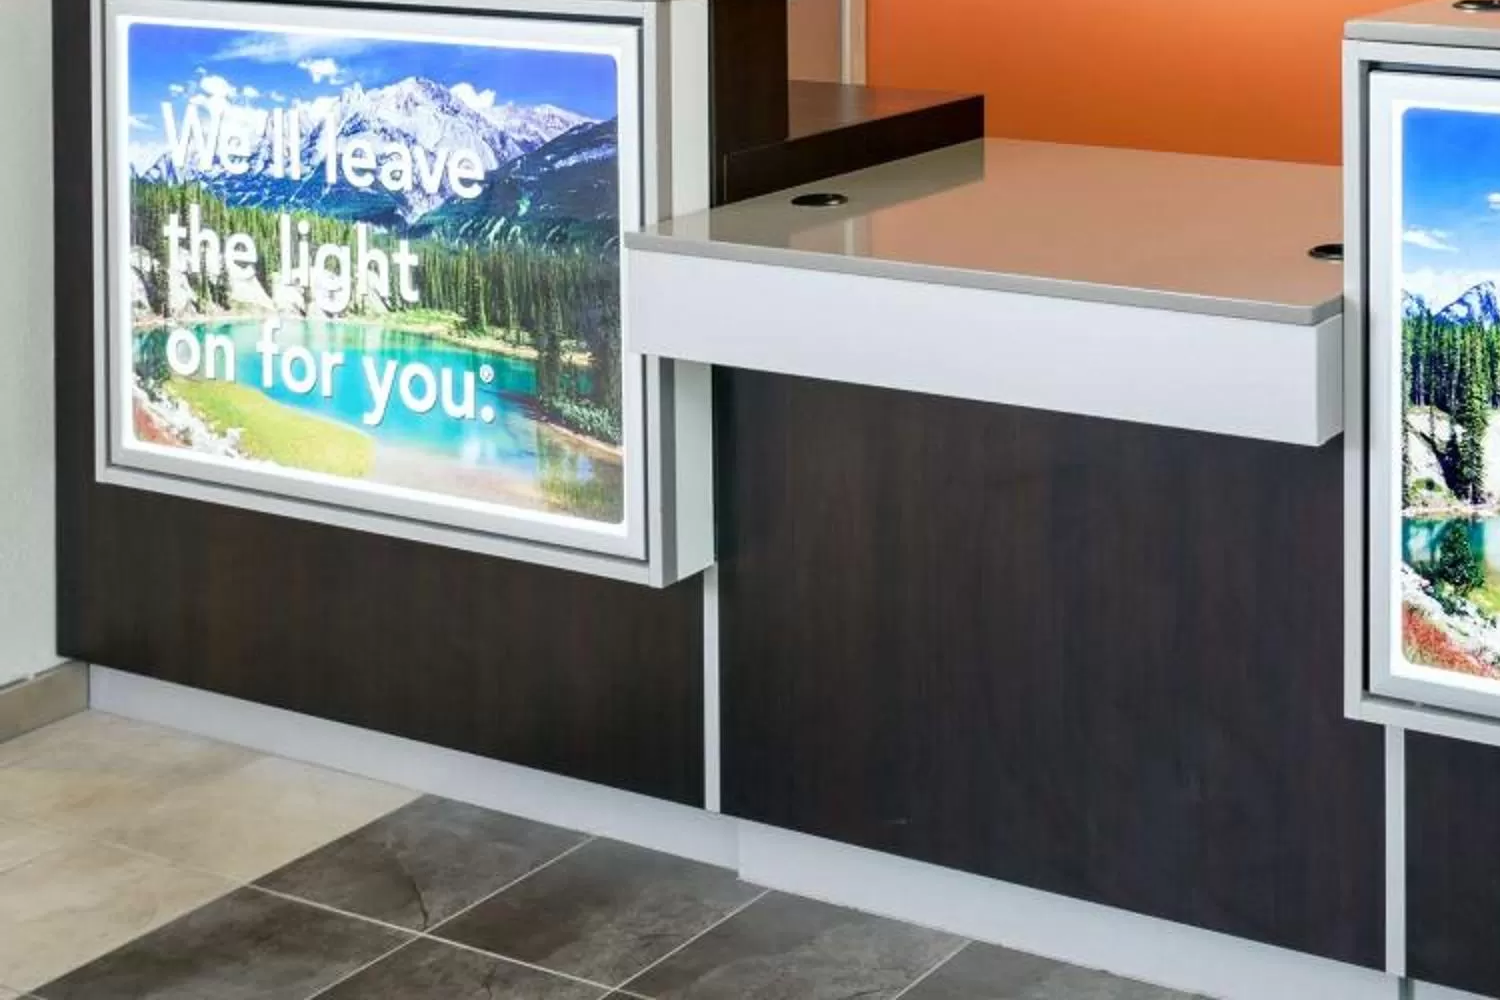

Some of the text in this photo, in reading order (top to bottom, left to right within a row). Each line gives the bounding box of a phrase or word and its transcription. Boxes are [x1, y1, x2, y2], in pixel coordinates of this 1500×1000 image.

[160, 101, 485, 199] We'll leave
[163, 203, 420, 314] the light
[166, 328, 236, 382] on
[257, 320, 345, 397] for
